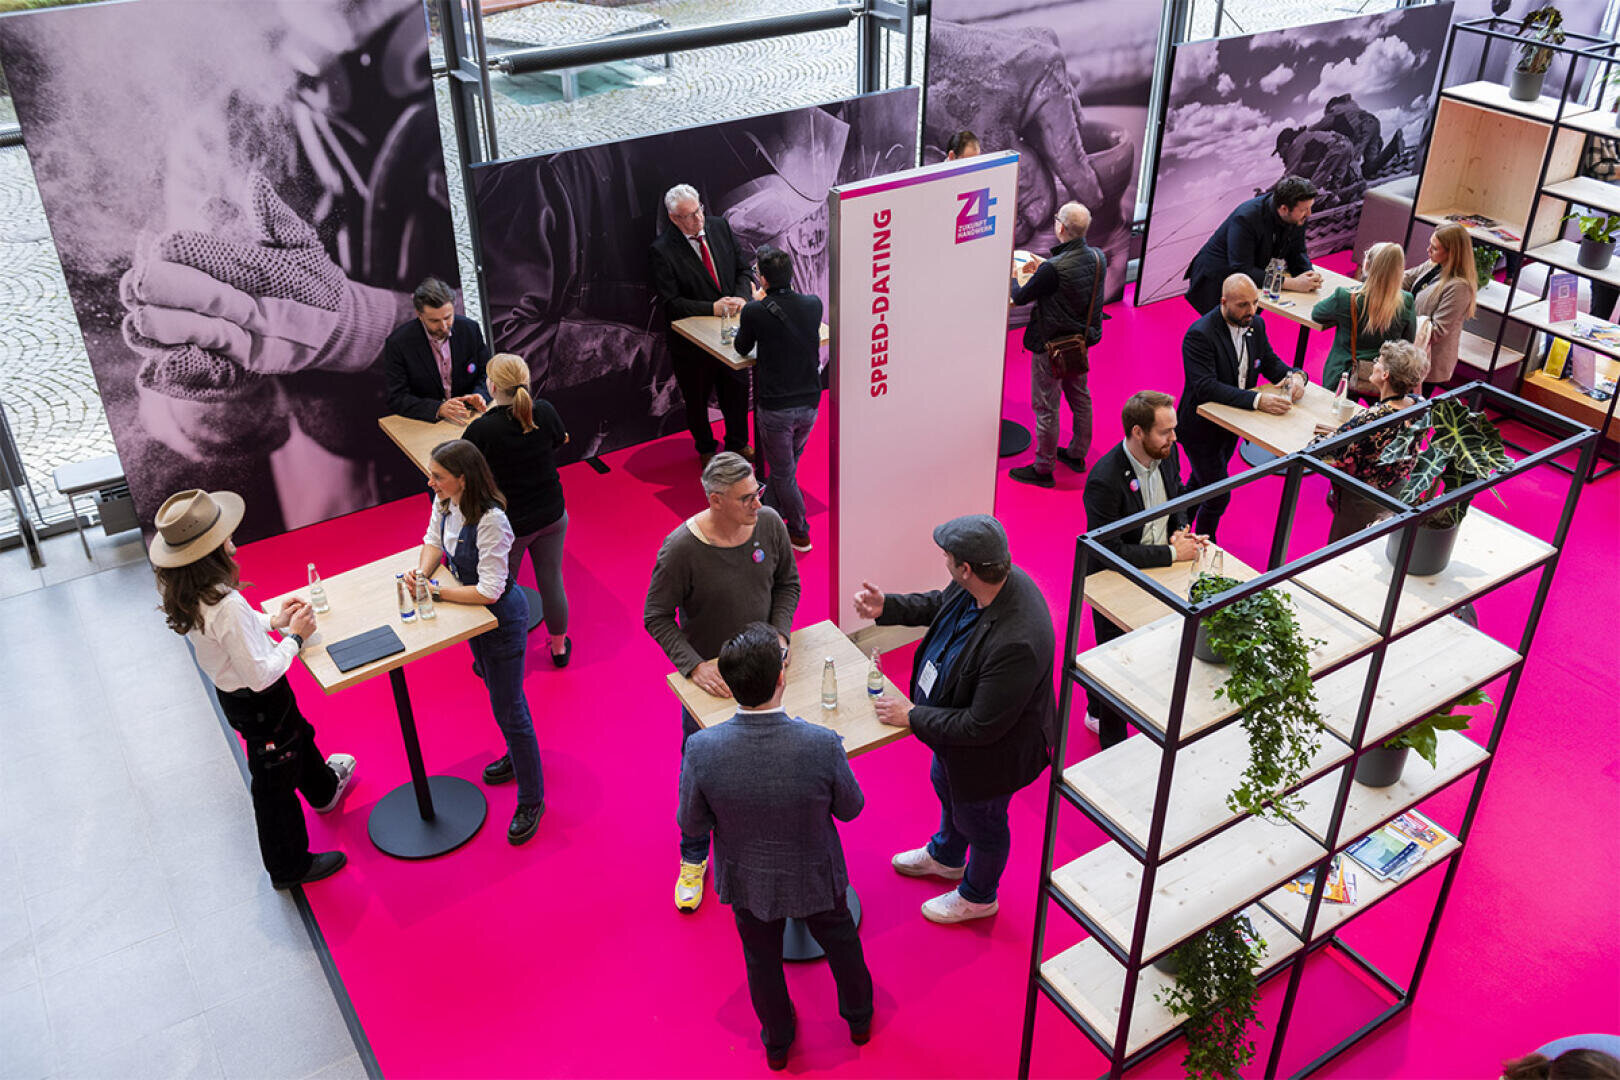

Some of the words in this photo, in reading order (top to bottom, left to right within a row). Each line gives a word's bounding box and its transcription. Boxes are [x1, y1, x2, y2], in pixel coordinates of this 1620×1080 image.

[958, 219, 988, 233] ZUKUNFT
[958, 224, 993, 239] HANDWERK
[871, 208, 892, 398] SPEED-DATING
